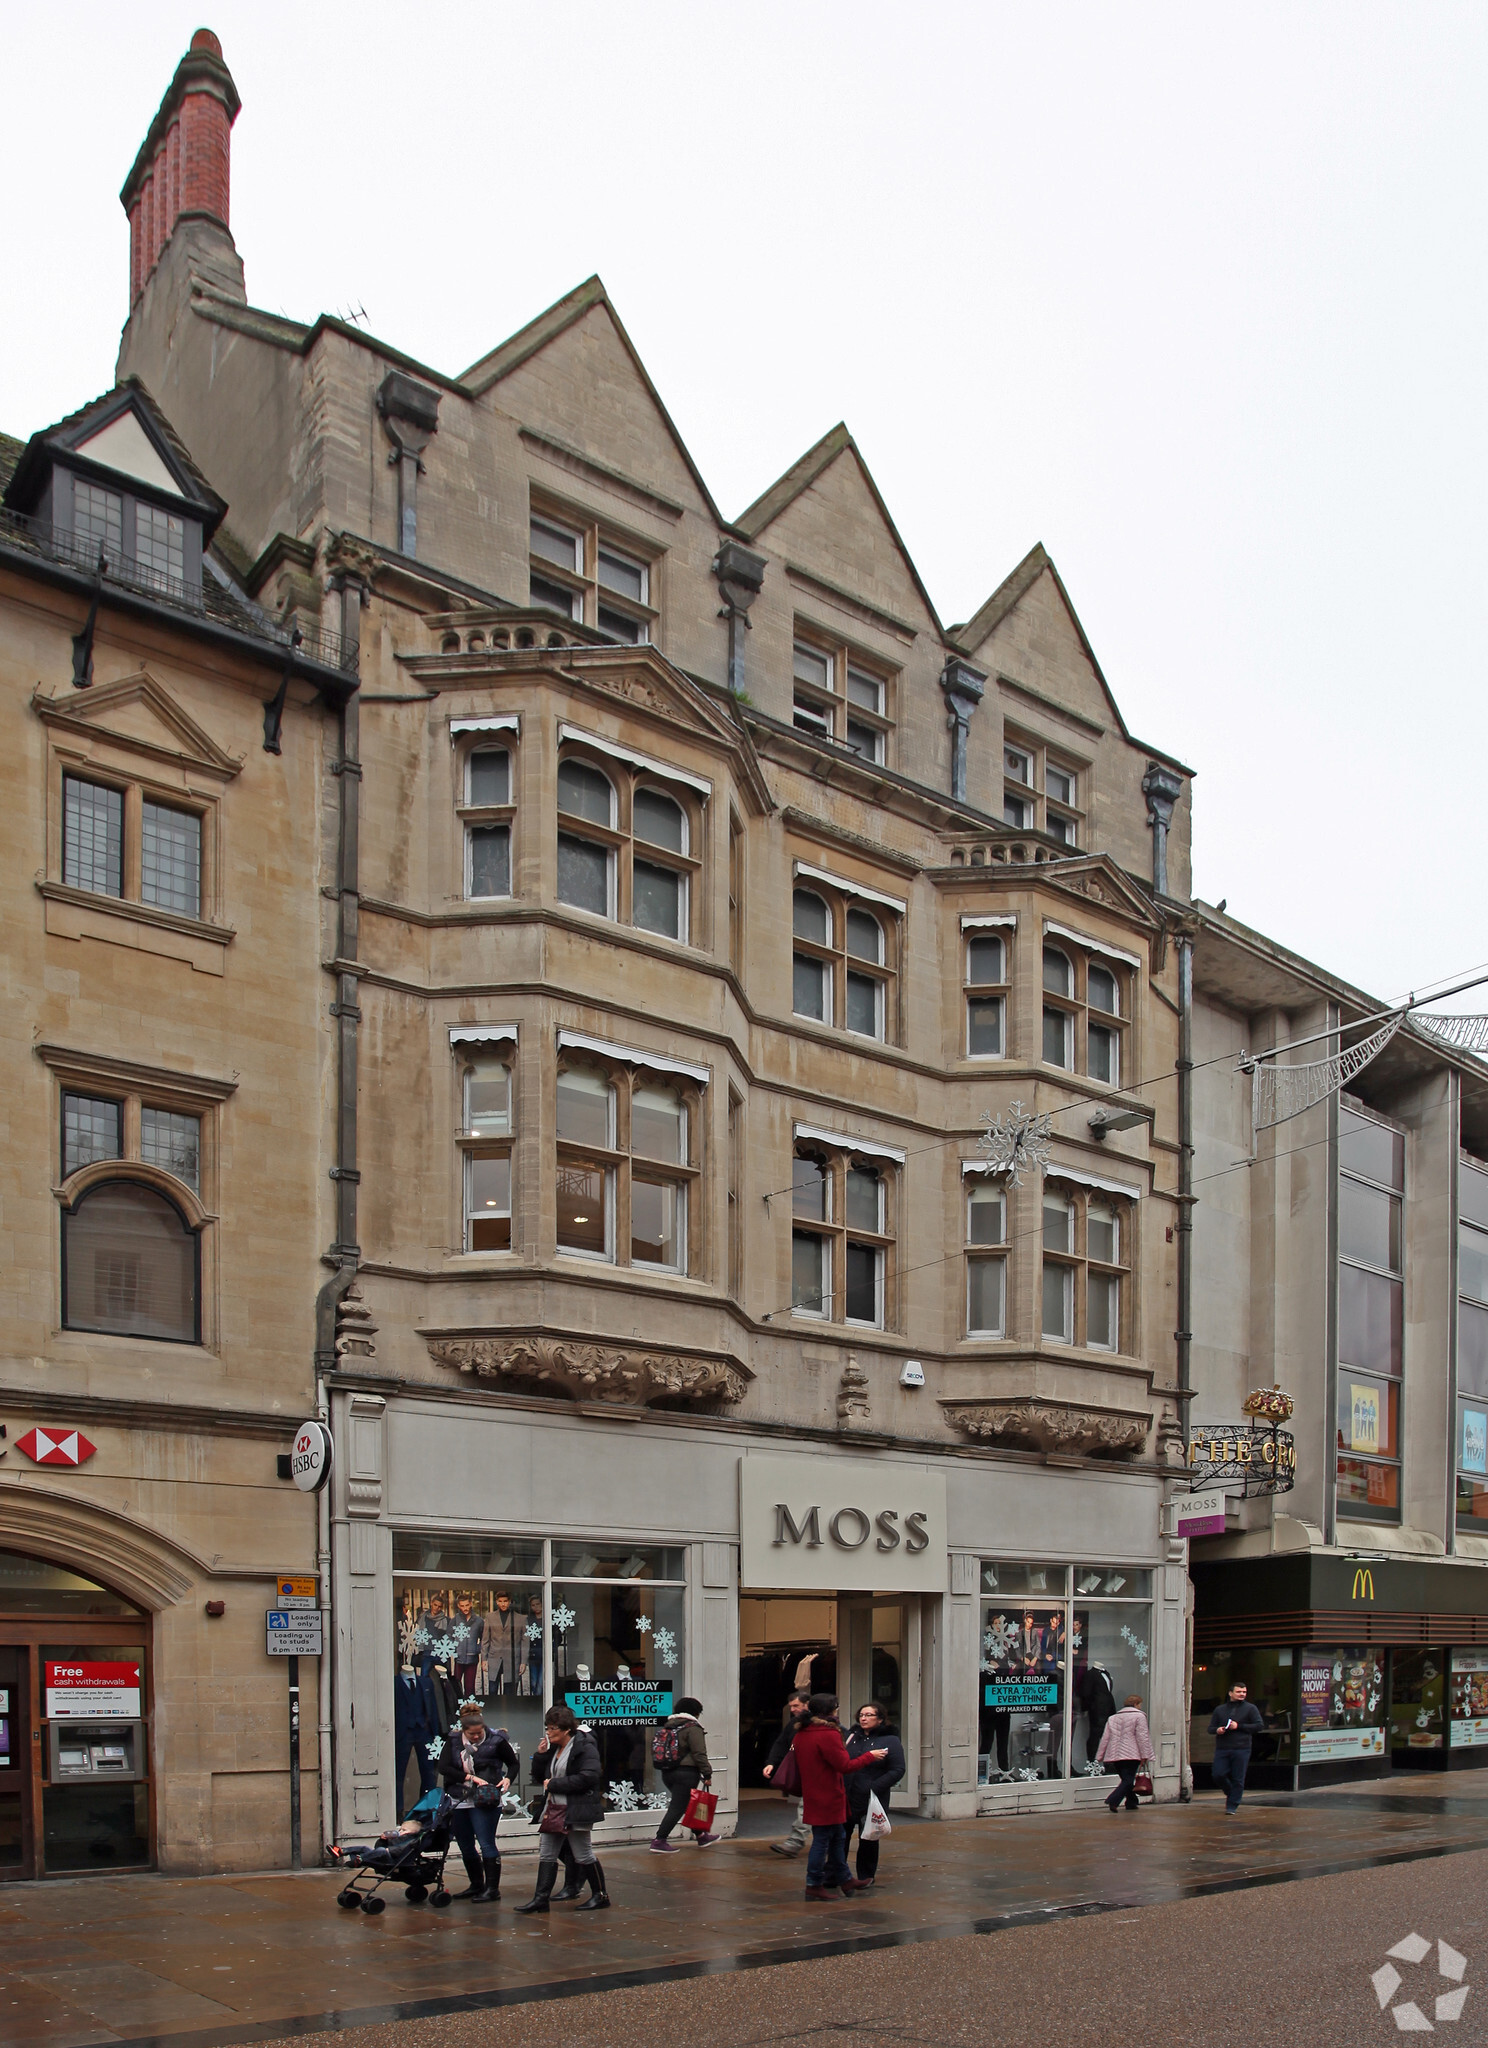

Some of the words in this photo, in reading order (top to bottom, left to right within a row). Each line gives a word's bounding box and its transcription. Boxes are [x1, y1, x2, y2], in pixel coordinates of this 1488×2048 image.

[1190, 1440, 1252, 1462] THE
[1262, 1442, 1296, 1469] CRO
[292, 1452, 319, 1475] HSBC
[1181, 1499, 1217, 1512] MOSS
[772, 1504, 929, 1550] MOSS
[54, 1666, 83, 1676] Free
[1301, 1669, 1329, 1680] HIRING
[580, 1682, 618, 1691] BLACK
[621, 1682, 659, 1690] FRIDAY
[1304, 1681, 1325, 1692] NOW!
[575, 1695, 616, 1704] EXTRA
[620, 1695, 641, 1704] 20%
[643, 1695, 664, 1704] OFF
[998, 1695, 1047, 1703] EVERYTHING
[584, 1705, 657, 1714] EVERYTHING
